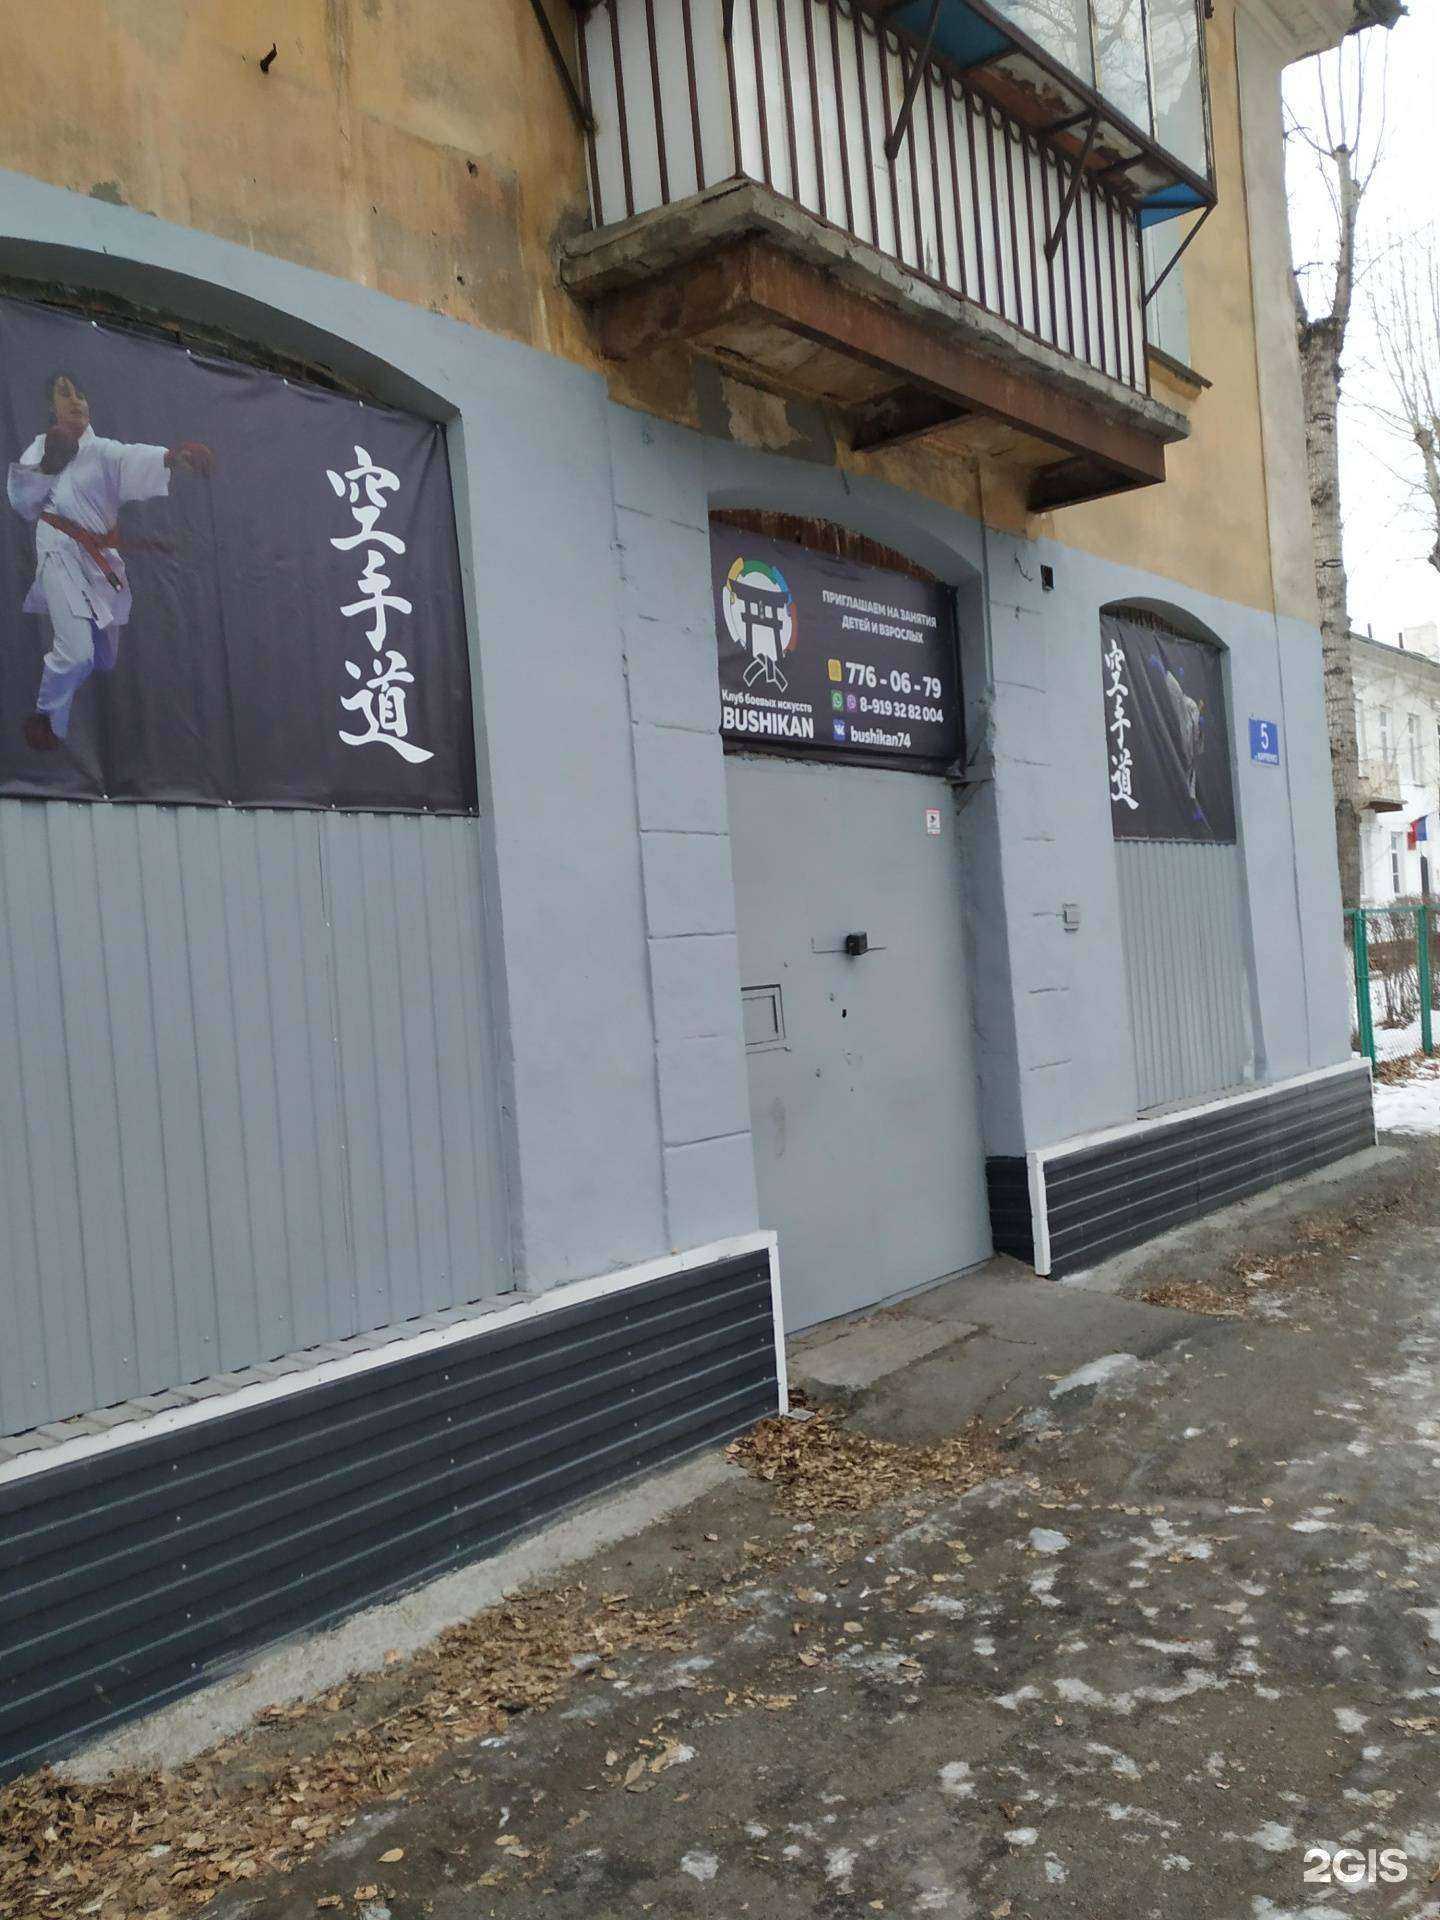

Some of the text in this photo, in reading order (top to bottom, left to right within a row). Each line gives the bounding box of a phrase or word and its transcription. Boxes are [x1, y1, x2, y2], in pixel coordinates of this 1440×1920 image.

[822, 589, 937, 629] ПРИГЛАШАЕМ НА ЗАНЯТИЯ
[842, 614, 924, 644] ДЕТЕЙ И ВЗРОСЛЫХ
[721, 688, 813, 714] Клуб боевых искусств
[722, 706, 814, 739] BUSHIKAN
[850, 725, 911, 749] bushikan74
[1260, 722, 1269, 750] 5
